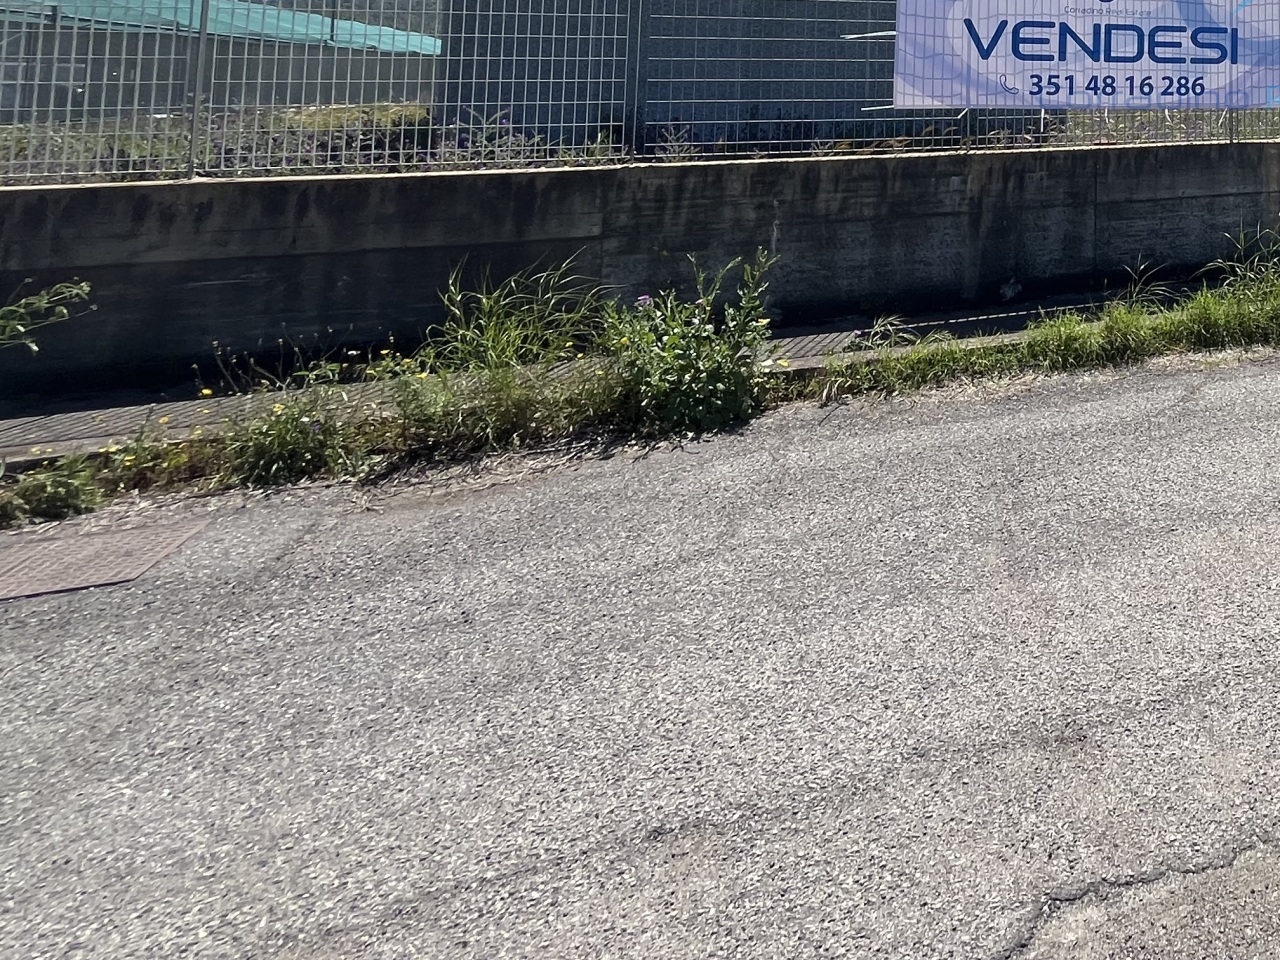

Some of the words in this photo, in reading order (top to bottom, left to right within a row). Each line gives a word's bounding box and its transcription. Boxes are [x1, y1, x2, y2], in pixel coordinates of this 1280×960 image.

[963, 18, 1238, 65] VENDESI
[1028, 74, 1075, 96] 351
[1085, 75, 1117, 96] 48
[1125, 75, 1154, 96] 16
[1160, 75, 1206, 96] 286
